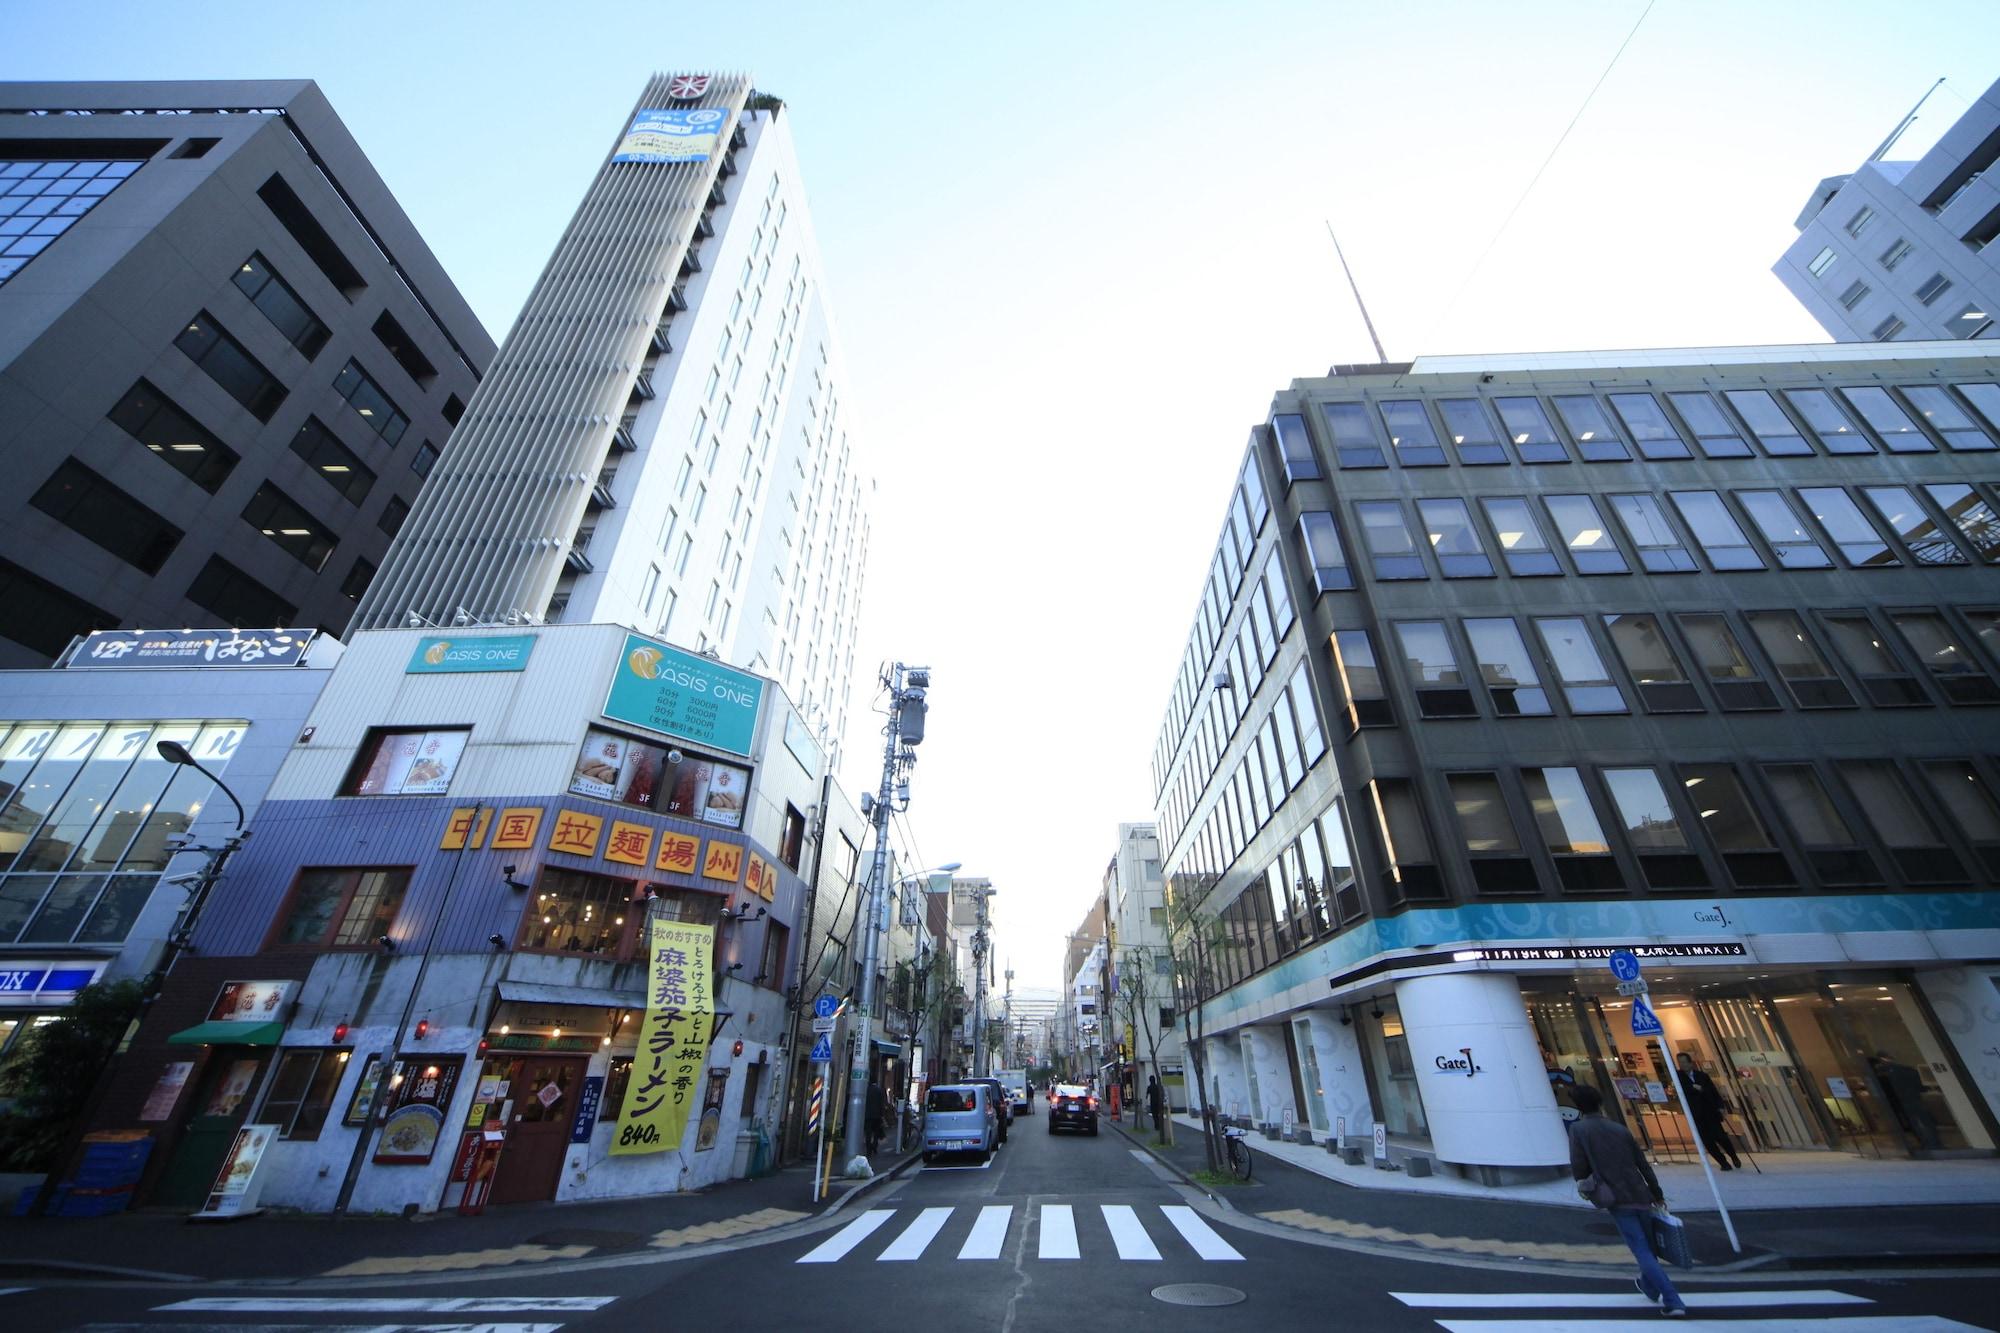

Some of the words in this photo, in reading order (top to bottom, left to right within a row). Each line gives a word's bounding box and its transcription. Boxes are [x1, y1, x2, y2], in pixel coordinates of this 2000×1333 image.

[204, 634, 293, 662] はなこ
[485, 649, 520, 660] ONE
[689, 696, 719, 712] 3000円
[713, 685, 755, 708] ONE
[684, 714, 715, 731] 9000円
[687, 706, 717, 722] 6000円
[15, 730, 239, 757] ルノアル
[360, 781, 374, 790] 3F
[639, 793, 650, 803] 3F
[669, 802, 680, 811] 3F
[654, 927, 712, 945] 秋のおすすめ
[1615, 959, 1627, 978] P
[820, 1000, 830, 1016] P
[630, 947, 689, 1118] 麻婆茄子ラーメン
[671, 947, 710, 1105] とろけるナスと山椒の香り
[620, 1124, 660, 1146] 840円
